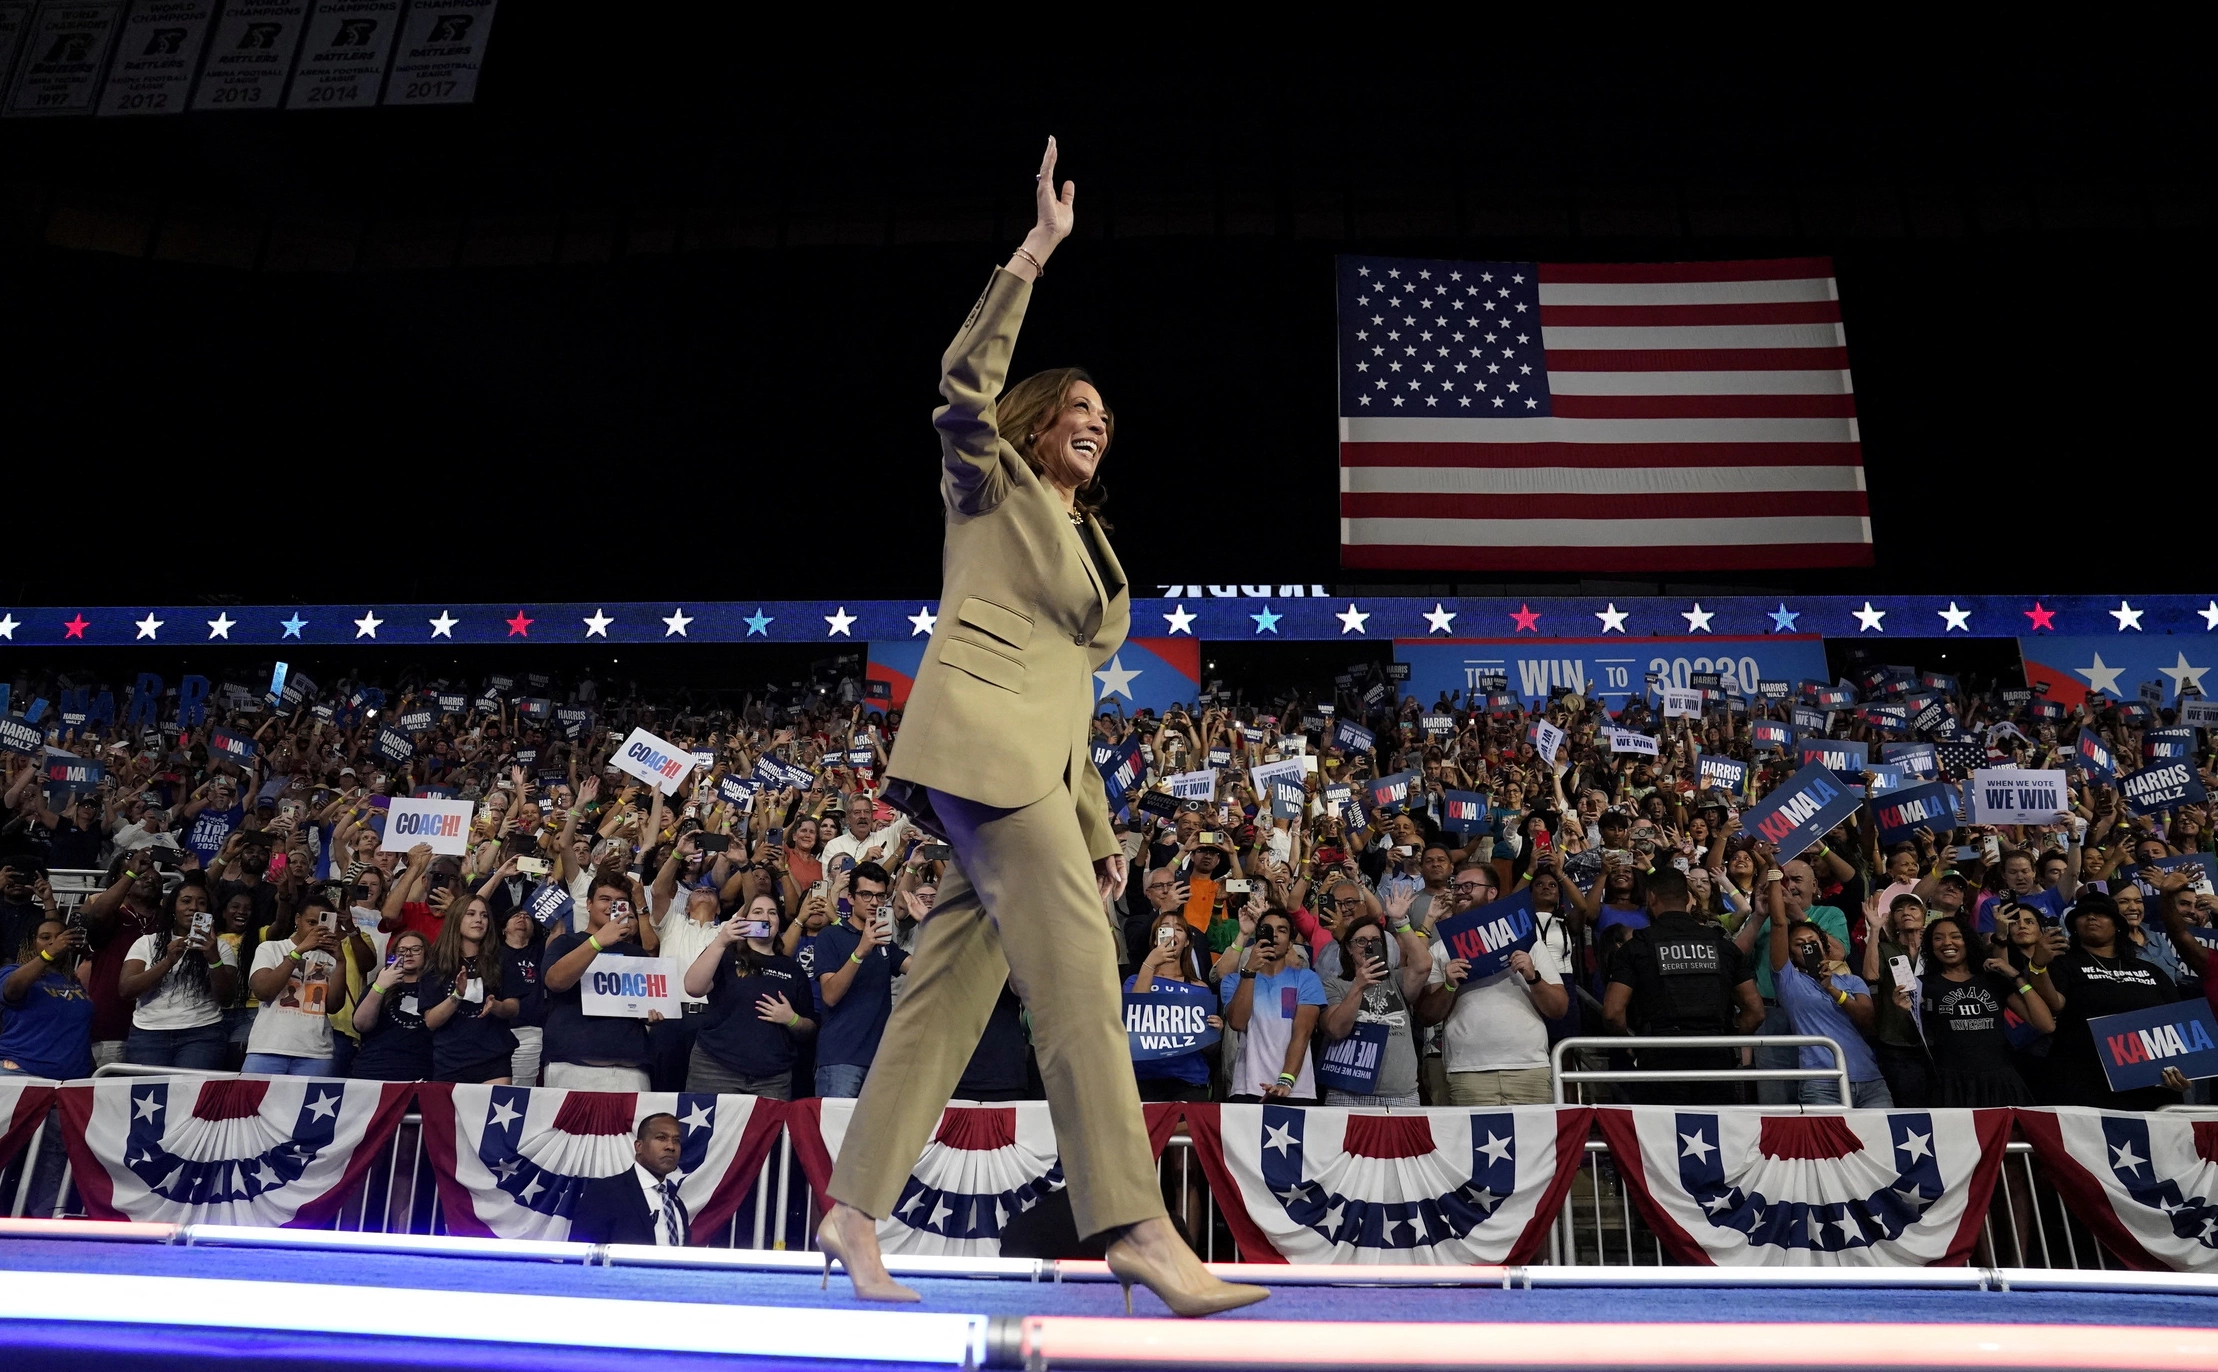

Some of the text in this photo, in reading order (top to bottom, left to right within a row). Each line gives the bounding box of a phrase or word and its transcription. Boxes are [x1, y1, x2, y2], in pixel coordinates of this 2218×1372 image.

[319, 3, 397, 13] CHAMPIONS
[312, 51, 375, 62] RATTLERS
[409, 47, 472, 57] RATTLERS
[213, 87, 261, 102] 2013
[306, 86, 358, 101] 2014
[405, 81, 457, 98] 2017
[117, 94, 167, 109] 2012
[1386, 665, 1408, 675] HARRIS
[1517, 659, 1586, 696] WIN
[1605, 666, 1629, 688] TO
[491, 676, 514, 688] HARRIS
[1693, 675, 1718, 685] HARRIS
[1760, 682, 1788, 693] HARRIS
[1364, 683, 1386, 702] HARRIS
[1820, 692, 1851, 704] KAMALA
[2003, 690, 2031, 702] HARRIS
[439, 696, 464, 707] HARRIS
[475, 698, 498, 711] HARRIS
[1317, 704, 1335, 712] HARRIS
[1669, 697, 1699, 711] WE WIN
[401, 712, 431, 725] HARRIS
[557, 709, 587, 721] HARRIS
[1422, 717, 1454, 729] HARRIS
[1794, 714, 1824, 730] WE WIN
[1868, 715, 1907, 729] KAMALA
[1913, 703, 1942, 730] HARRIS
[2187, 710, 2202, 720] WE
[406, 722, 427, 731] WALZ
[1244, 727, 1263, 736] HARRIS
[1920, 716, 1942, 732] WALZ
[0, 720, 42, 745] HARRIS
[1339, 729, 1372, 751] WE WIN
[1756, 727, 1793, 745] KAMALA
[3, 736, 33, 751] WALZ
[380, 730, 413, 757] HARRIS
[1616, 738, 1653, 749] WE WIN
[2143, 742, 2184, 758] KAMALA
[382, 744, 405, 762] WALZ
[516, 750, 536, 759] HARRIS
[627, 741, 683, 780] COACH!
[850, 752, 872, 760] HARRIS
[1209, 750, 1230, 760] HARRIS
[1804, 750, 1862, 771] KAMALA
[2082, 737, 2115, 774] KAMALA
[757, 757, 782, 777] HARRIS
[1700, 760, 1742, 781] HARRIS
[1913, 756, 1933, 771] WIN
[49, 765, 100, 783] KAMALA
[758, 768, 775, 782] WALZ
[785, 764, 813, 782] HARRIS
[1106, 749, 1143, 799] KAMALA
[2124, 763, 2191, 797] HARRIS
[721, 777, 751, 798] HARRIS
[1173, 781, 1210, 797] WE WIN
[1326, 787, 1351, 799] HARRIS
[2139, 785, 2186, 806] WALZ
[724, 789, 744, 803] WALZ
[1985, 789, 2058, 810] WE WIN
[1347, 809, 1357, 828] WALZ
[1350, 801, 1366, 828] HARRIS
[1448, 800, 1487, 821] KAMALA
[1758, 778, 1839, 843] KAMALA
[1878, 795, 1945, 830] KAMALA
[193, 820, 230, 836] STOP
[395, 812, 462, 838] COACH!
[190, 833, 228, 845] PROJEC
[535, 887, 568, 923] HARRIS
[1451, 908, 1533, 960] KAMALA
[1659, 944, 1716, 961] POLICE
[1662, 961, 1717, 971] SECRET SERVICE
[593, 971, 668, 998] COACH!
[1938, 986, 1999, 1015] HOWARD
[1959, 1003, 1981, 1016] HU
[1126, 1004, 1206, 1034] HARRIS
[1949, 1017, 1995, 1031] UNIVERSITY
[1140, 1035, 1196, 1050] WALZ
[2107, 1019, 2215, 1067] KAMALA
[1356, 1041, 1378, 1069] WE
[1321, 1062, 1372, 1080] WHEN WE FIGHT
